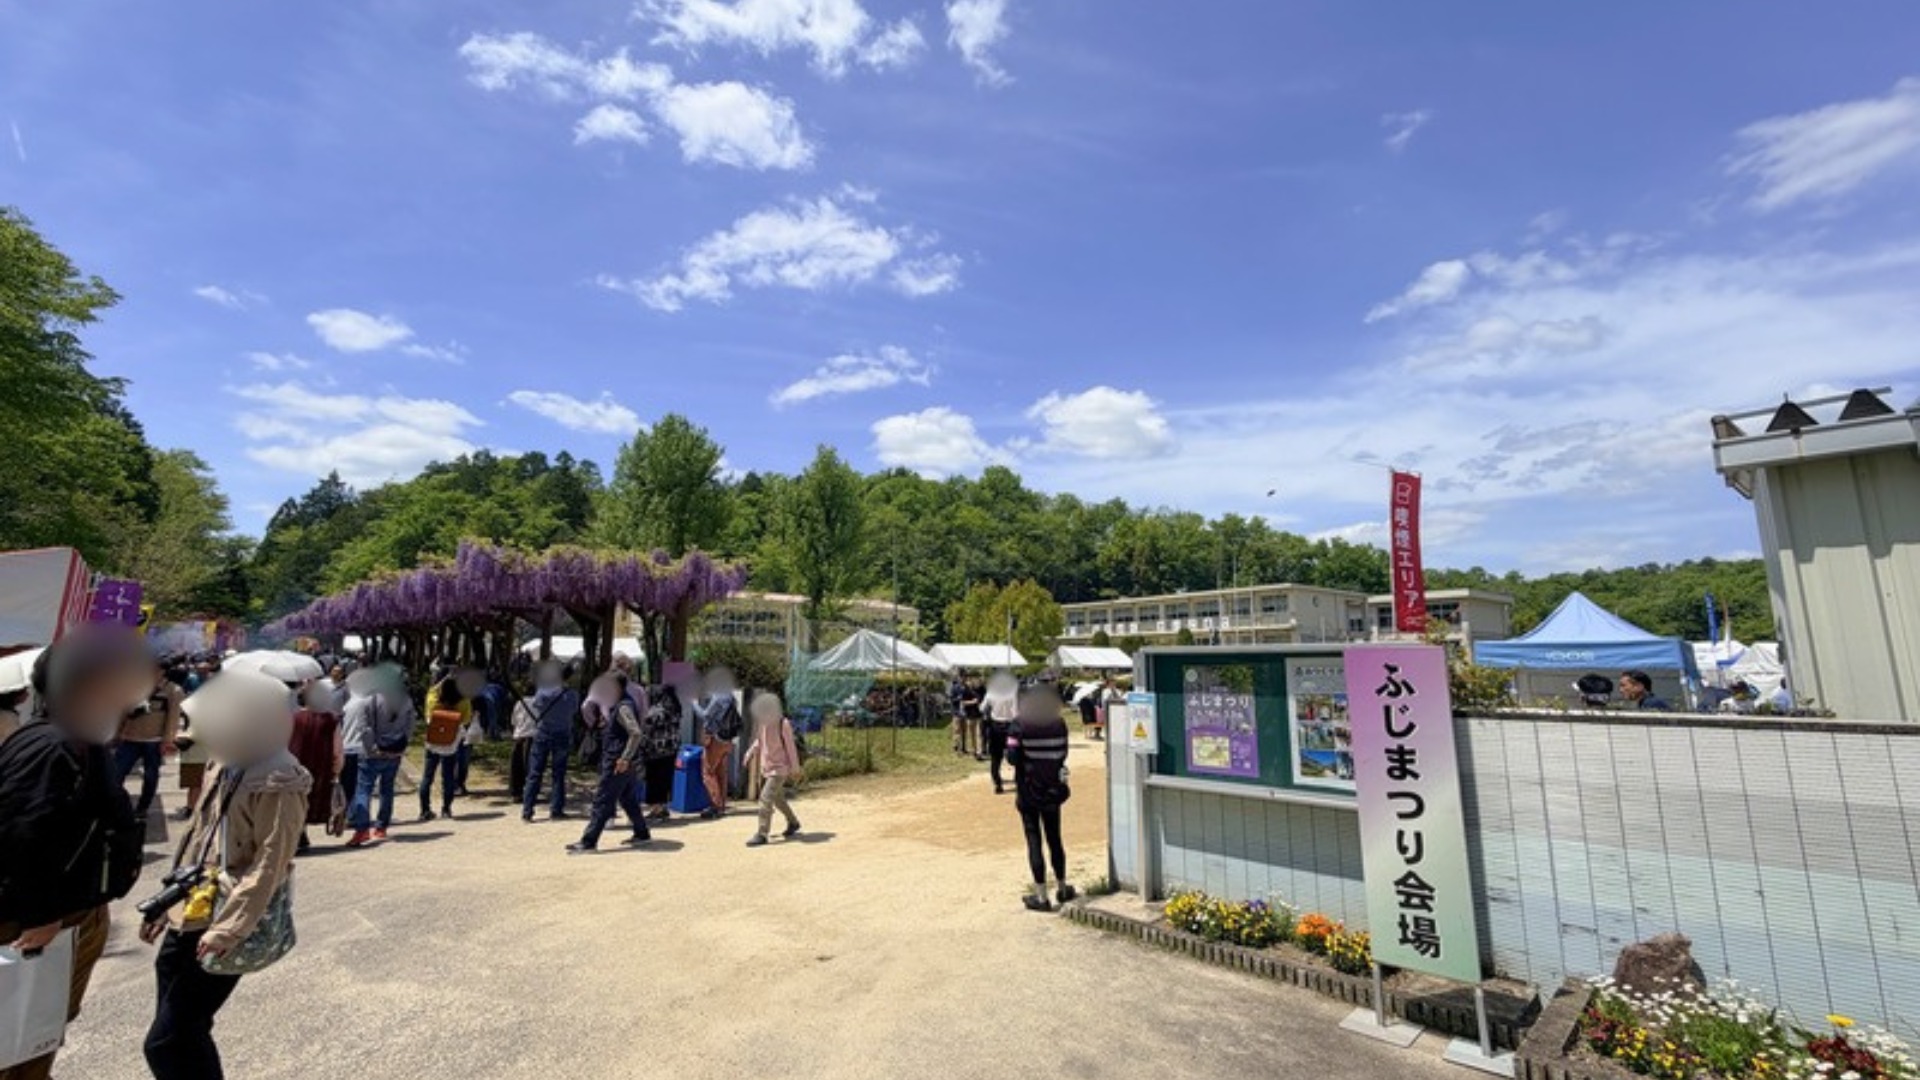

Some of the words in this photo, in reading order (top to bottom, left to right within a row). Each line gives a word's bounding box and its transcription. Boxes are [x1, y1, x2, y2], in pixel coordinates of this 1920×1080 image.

[1189, 694, 1249, 708] ふじまつり
[1375, 663, 1441, 959] ふじまつり会場
